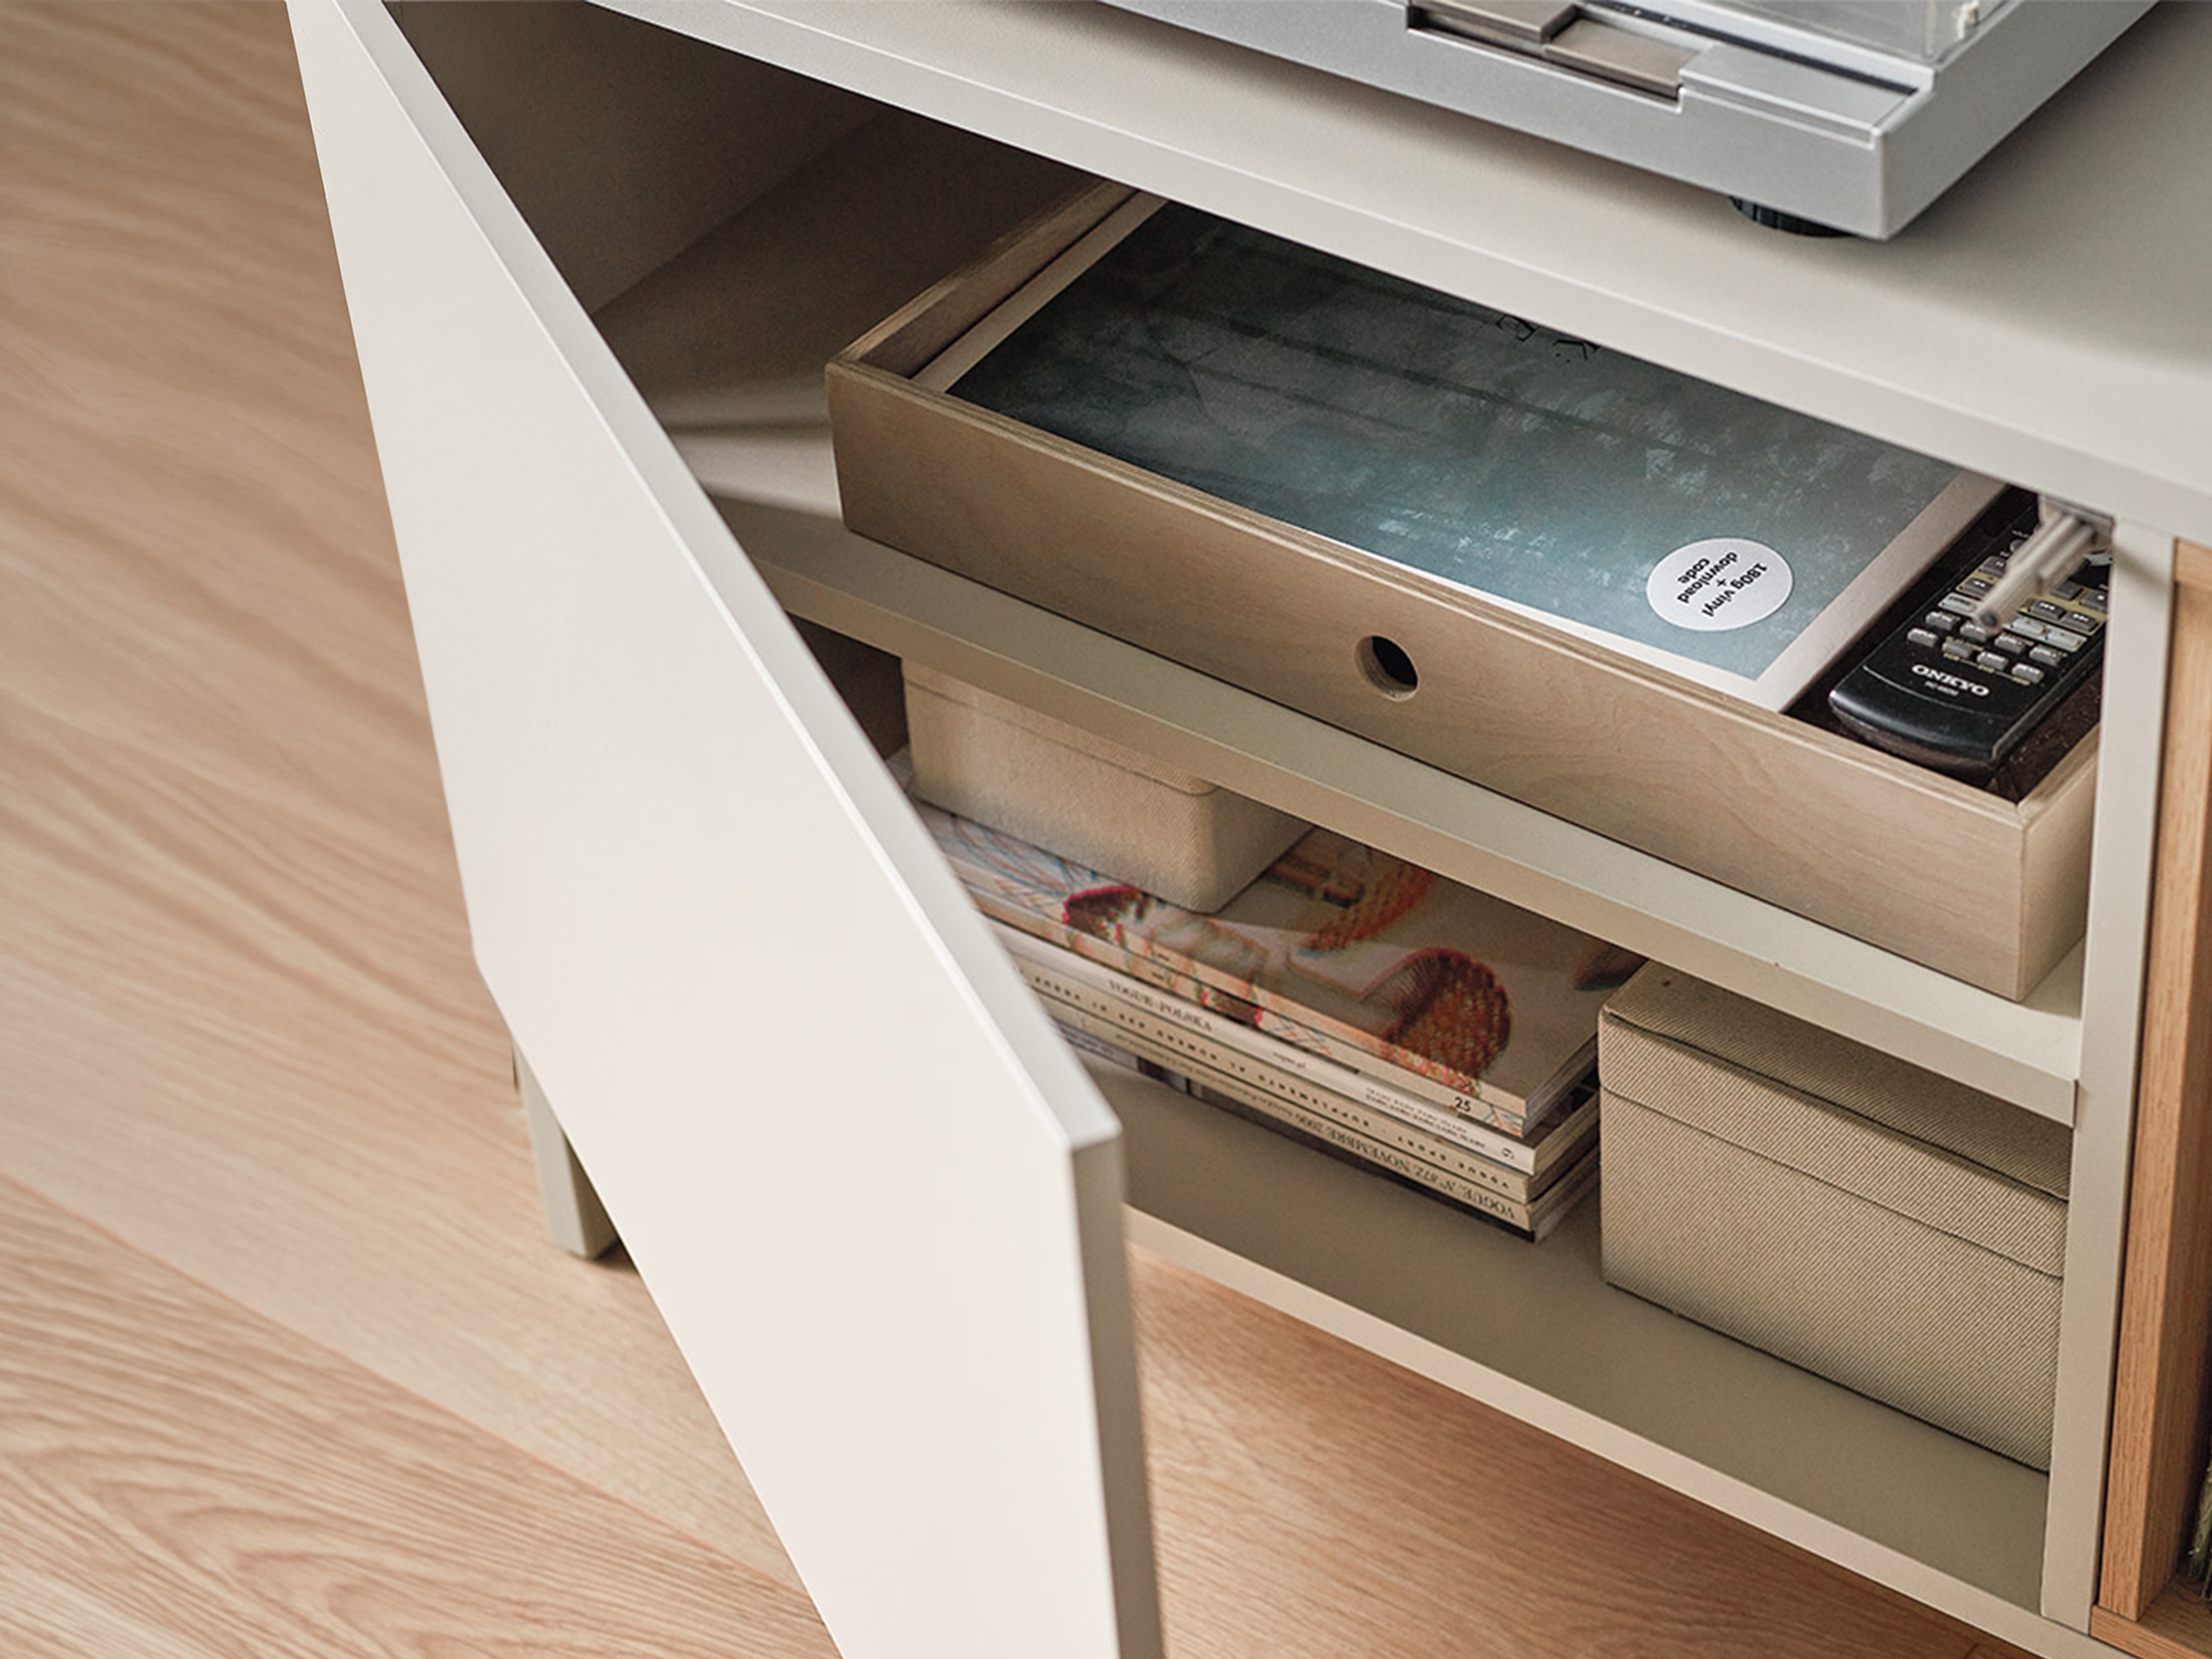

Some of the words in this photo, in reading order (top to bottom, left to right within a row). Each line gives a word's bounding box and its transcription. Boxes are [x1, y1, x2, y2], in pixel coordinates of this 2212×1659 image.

[1676, 551, 1738, 604] download
[1677, 557, 1710, 584] code
[1716, 578, 1729, 588] +
[1730, 562, 1768, 590] 180g
[1701, 588, 1736, 617] vinyl
[1911, 664, 1989, 696] ONKYO
[1455, 1096, 1471, 1112] 25
[1398, 1135, 1447, 1161] SPORT
[1458, 1161, 1509, 1189] VOGUE
